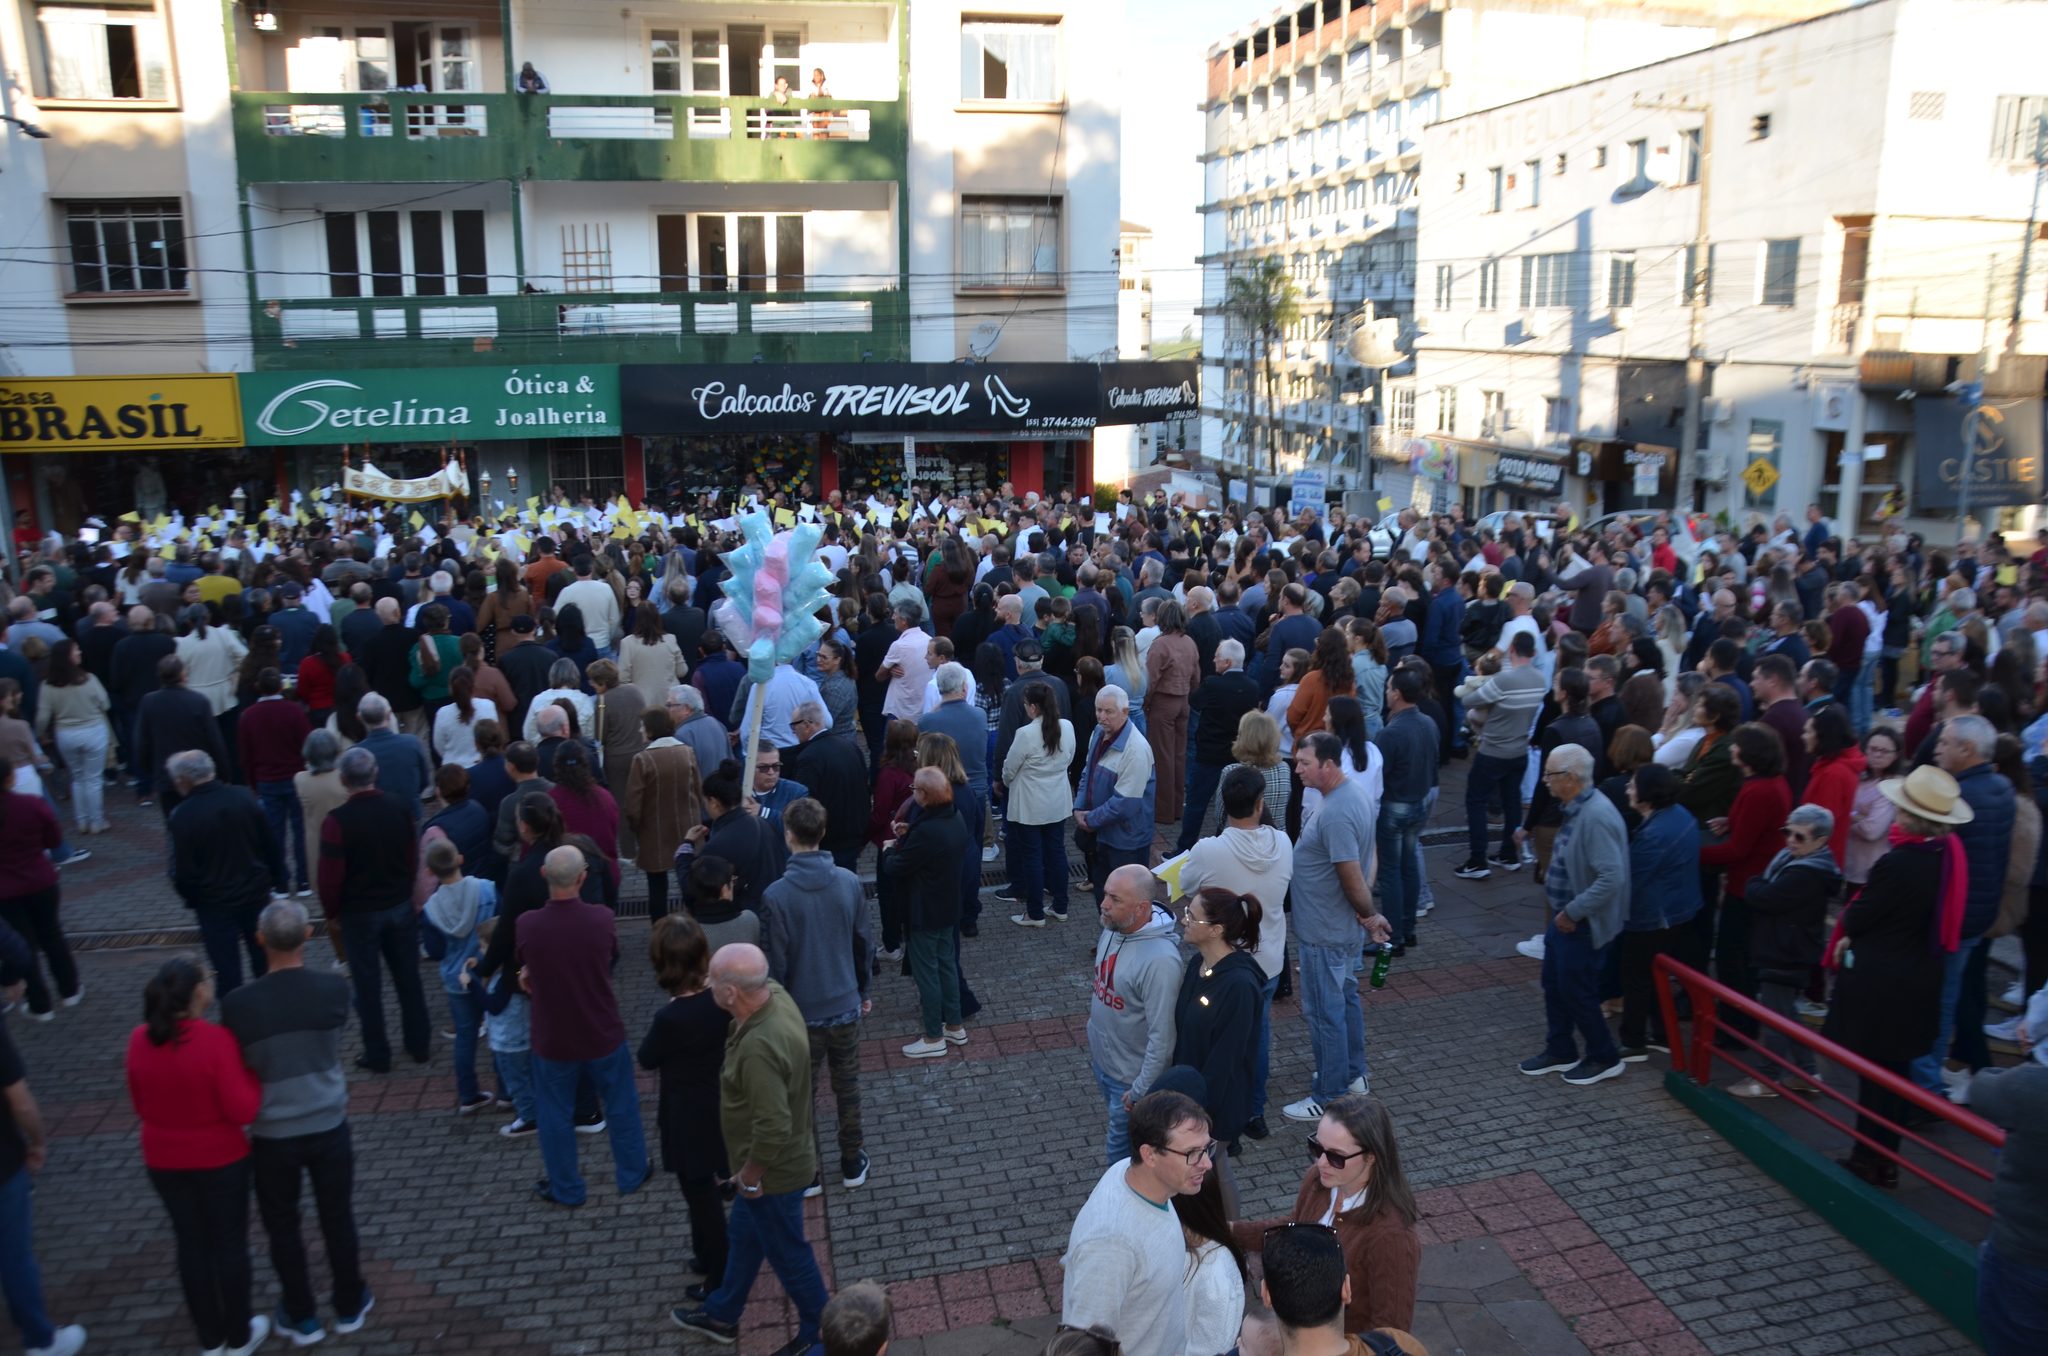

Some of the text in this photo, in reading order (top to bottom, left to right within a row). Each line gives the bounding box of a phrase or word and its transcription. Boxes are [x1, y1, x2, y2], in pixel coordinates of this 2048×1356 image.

[505, 369, 595, 395] Ótica &
[0, 387, 56, 405] Casa
[691, 381, 970, 420] Calçados TREVISOL
[1142, 386, 1182, 407] TREVISOL
[256, 379, 471, 436] Getelina
[495, 403, 607, 426] Joalheria
[1042, 416, 1097, 427] 3744-2945
[1499, 457, 1525, 477] FOTO
